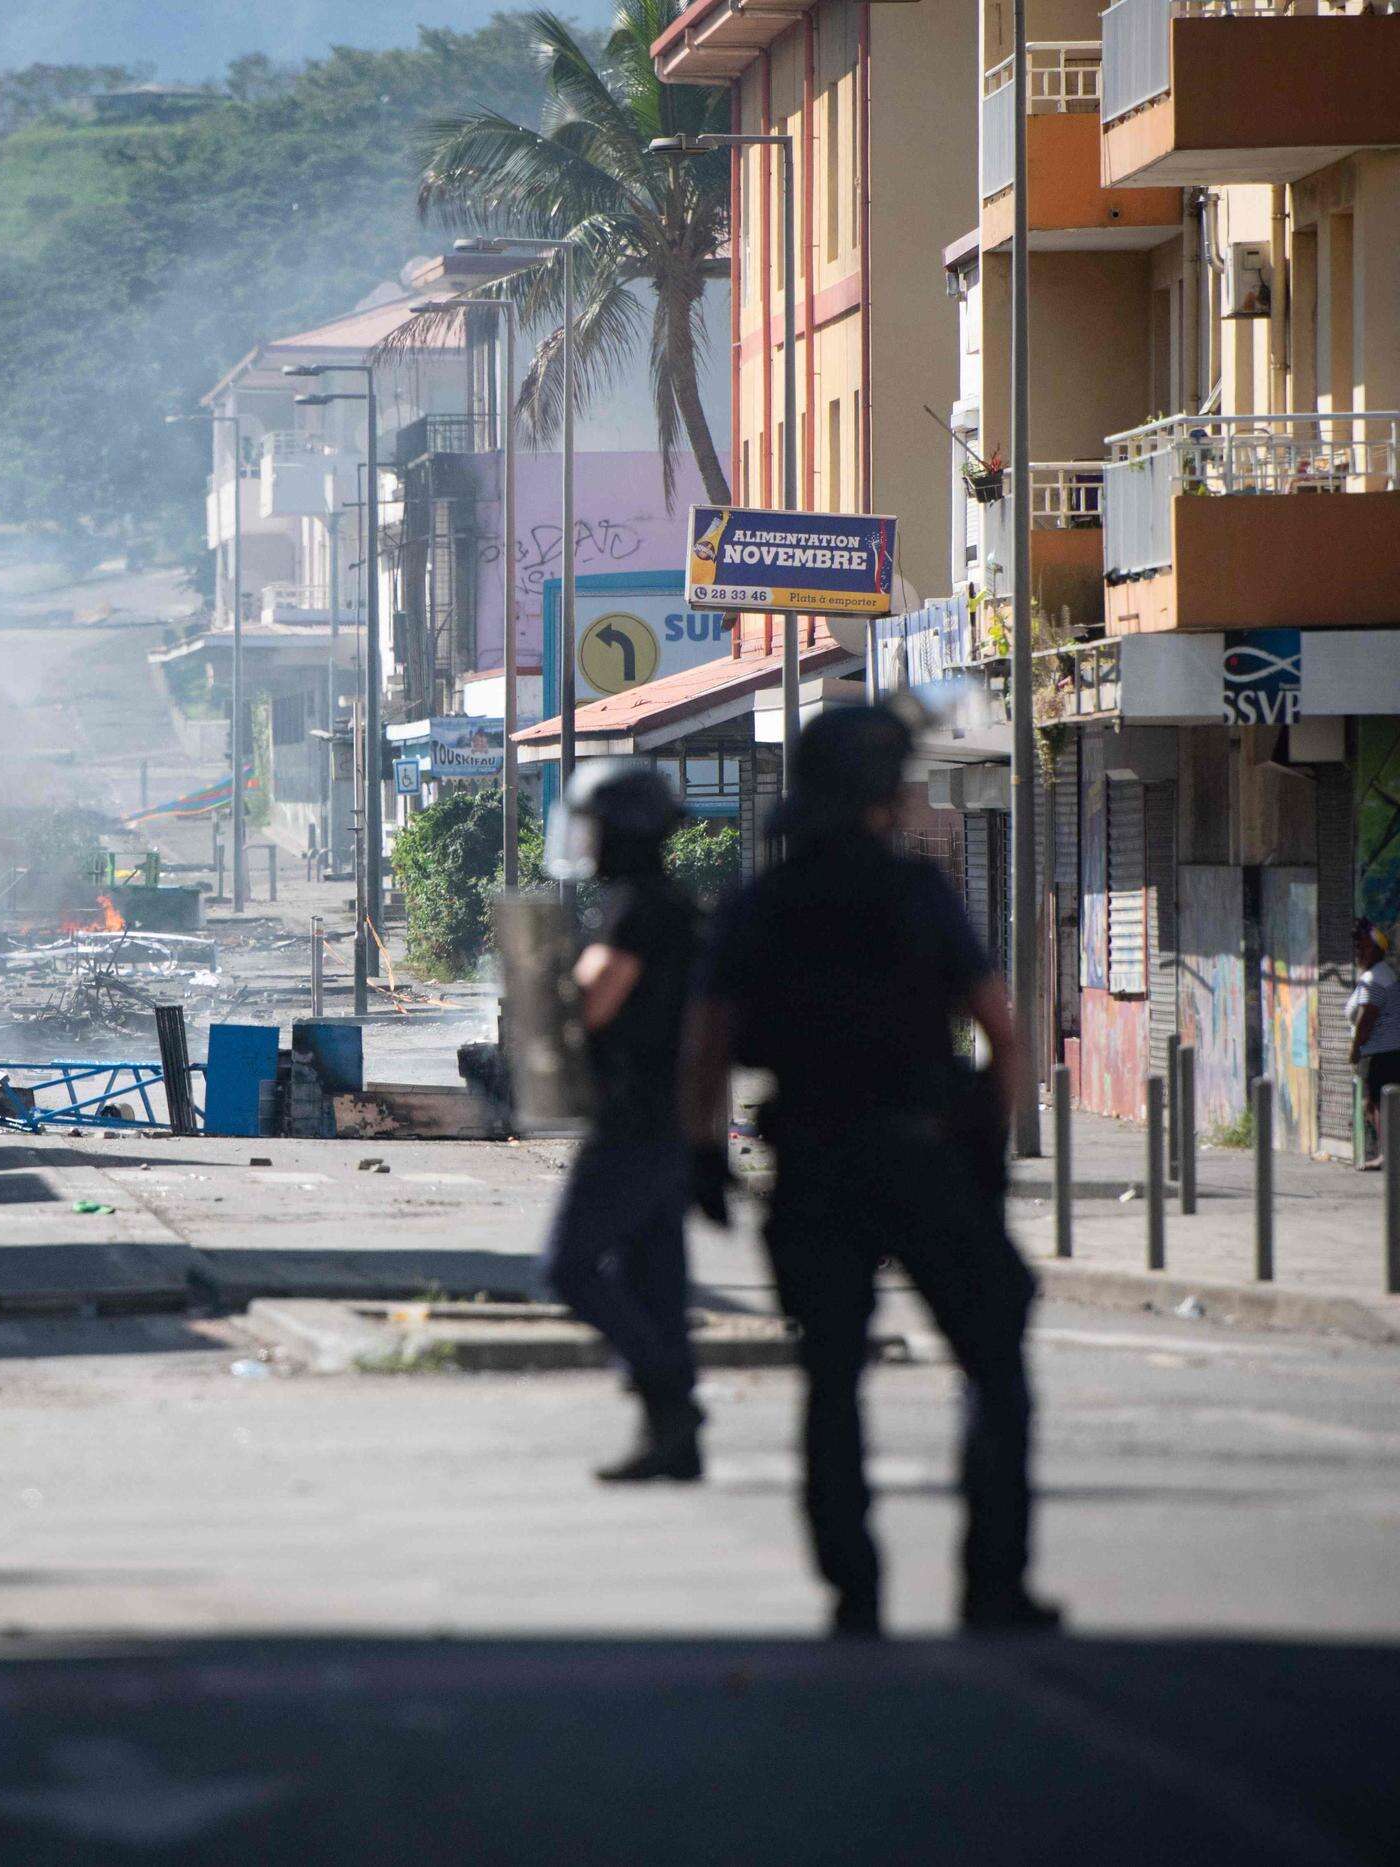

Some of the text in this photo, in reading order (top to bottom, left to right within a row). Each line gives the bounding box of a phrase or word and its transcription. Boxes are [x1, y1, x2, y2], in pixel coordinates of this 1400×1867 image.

[733, 530, 860, 548] ALIMENTATION
[723, 544, 867, 570] NOVEMBRE
[712, 589, 767, 601] 28 33 46
[790, 592, 816, 604] Plats
[828, 598, 877, 607] emporter
